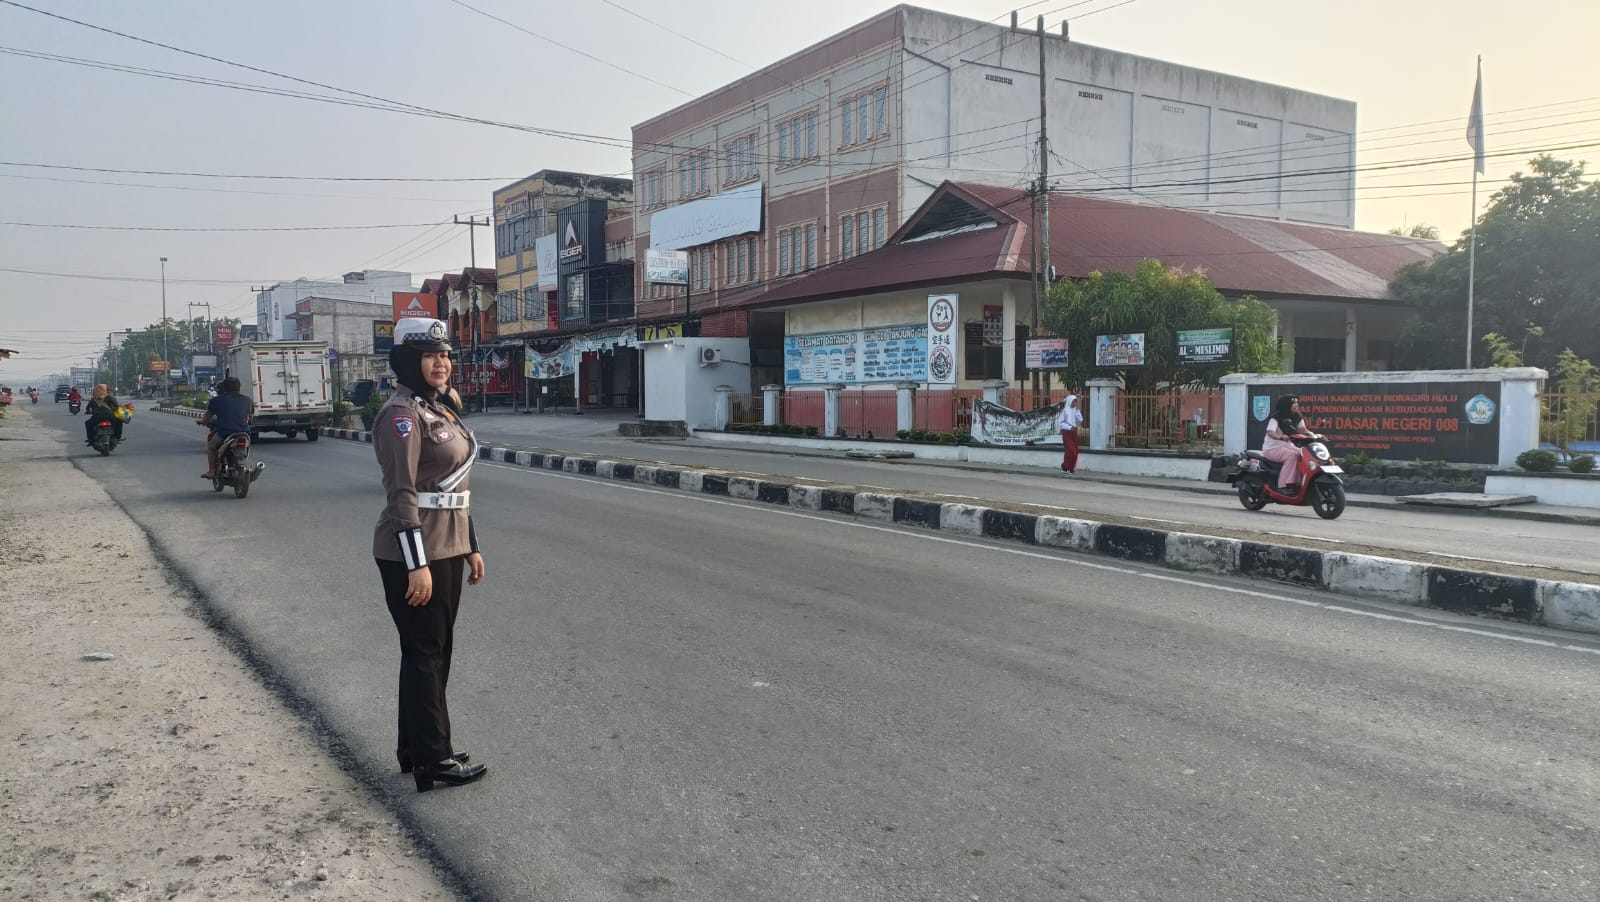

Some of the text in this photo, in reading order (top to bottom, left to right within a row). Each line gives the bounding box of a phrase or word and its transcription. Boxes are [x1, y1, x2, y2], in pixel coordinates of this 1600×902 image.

[560, 245, 583, 259] EIGER
[888, 328, 915, 340] TANJUNG
[798, 334, 824, 347] SELAMAT
[825, 334, 849, 346] DATANG
[1178, 345, 1188, 356] AL
[1195, 344, 1229, 355] MUSLIMIN
[1299, 394, 1458, 402] RINTAH KABUPATEN INDRAGIRI HULU
[1312, 405, 1363, 414] PENDIDIKAN
[1364, 406, 1383, 414] DAN
[1384, 406, 1447, 414] KEBUDAYAAN
[1335, 417, 1378, 430] DASAR
[1382, 418, 1432, 431] NEGERI
[1436, 418, 1459, 432] 008
